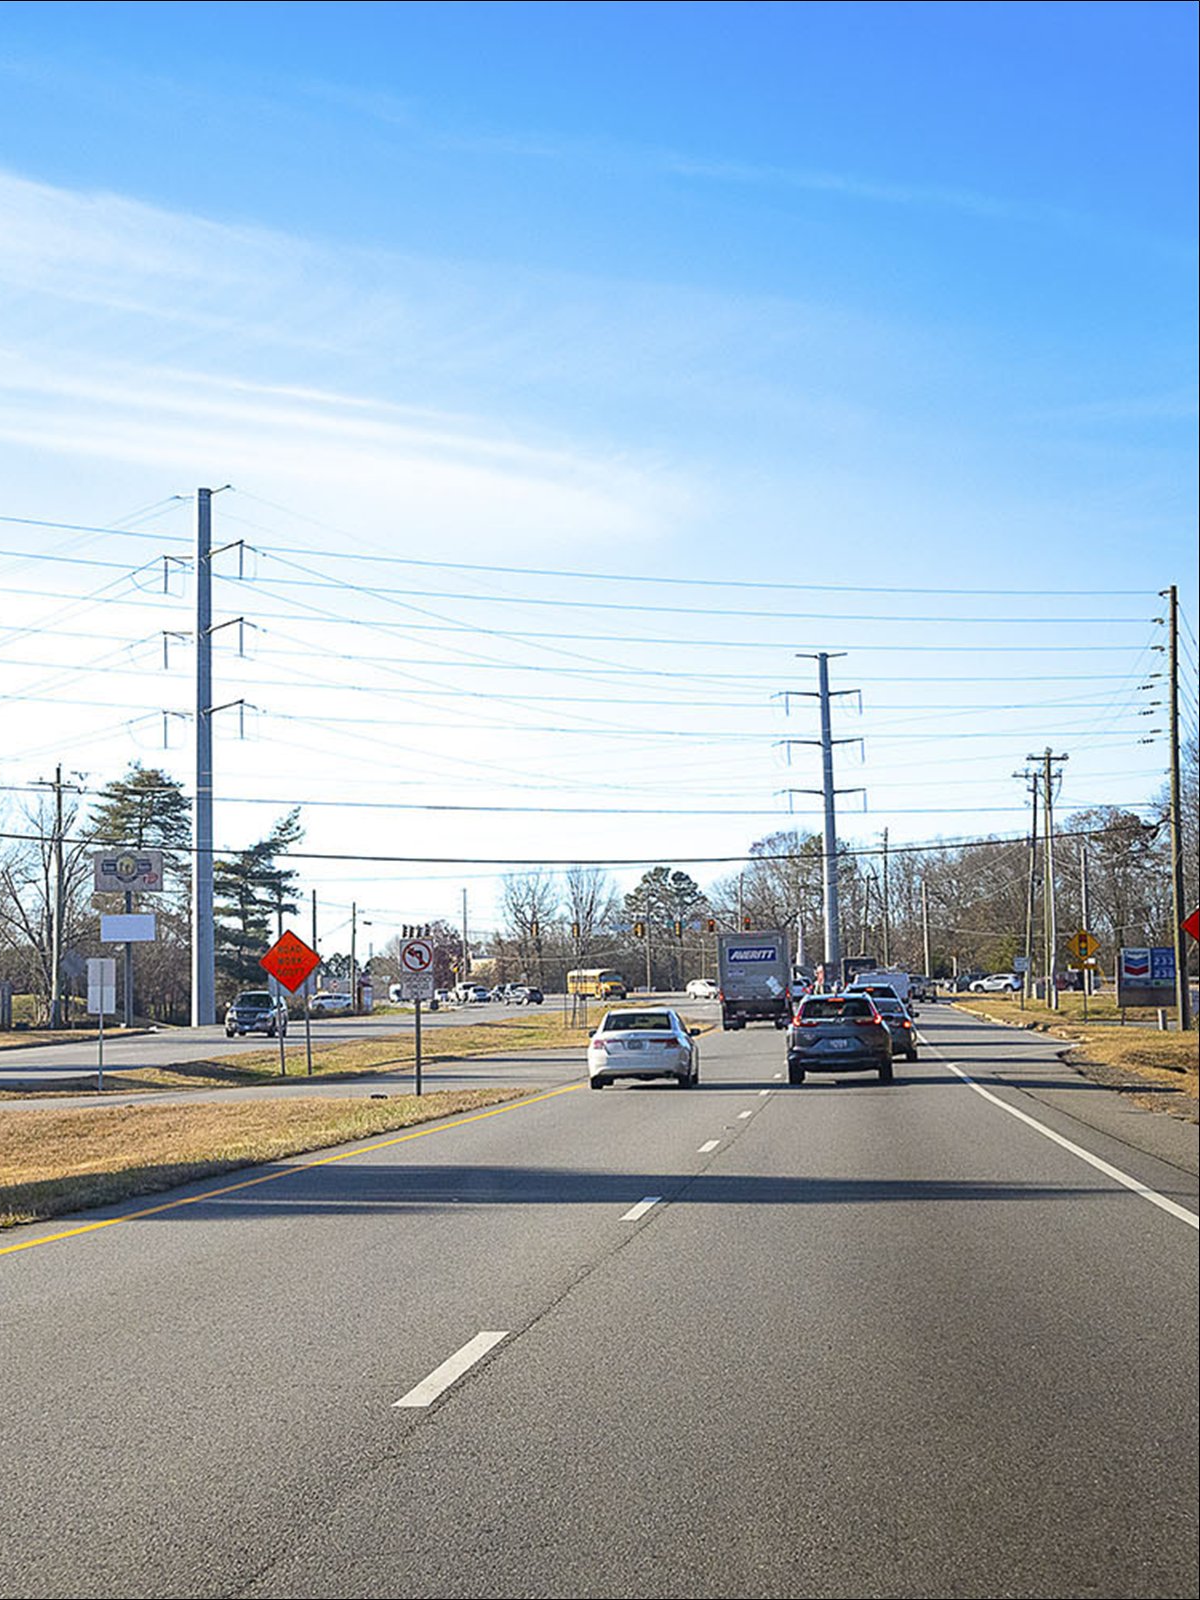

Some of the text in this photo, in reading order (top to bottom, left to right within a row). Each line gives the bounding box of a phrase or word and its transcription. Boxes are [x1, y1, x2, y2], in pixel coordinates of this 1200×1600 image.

[277, 945, 303, 954] ROAD
[730, 949, 774, 960] AVERITT
[278, 957, 301, 965] WORK
